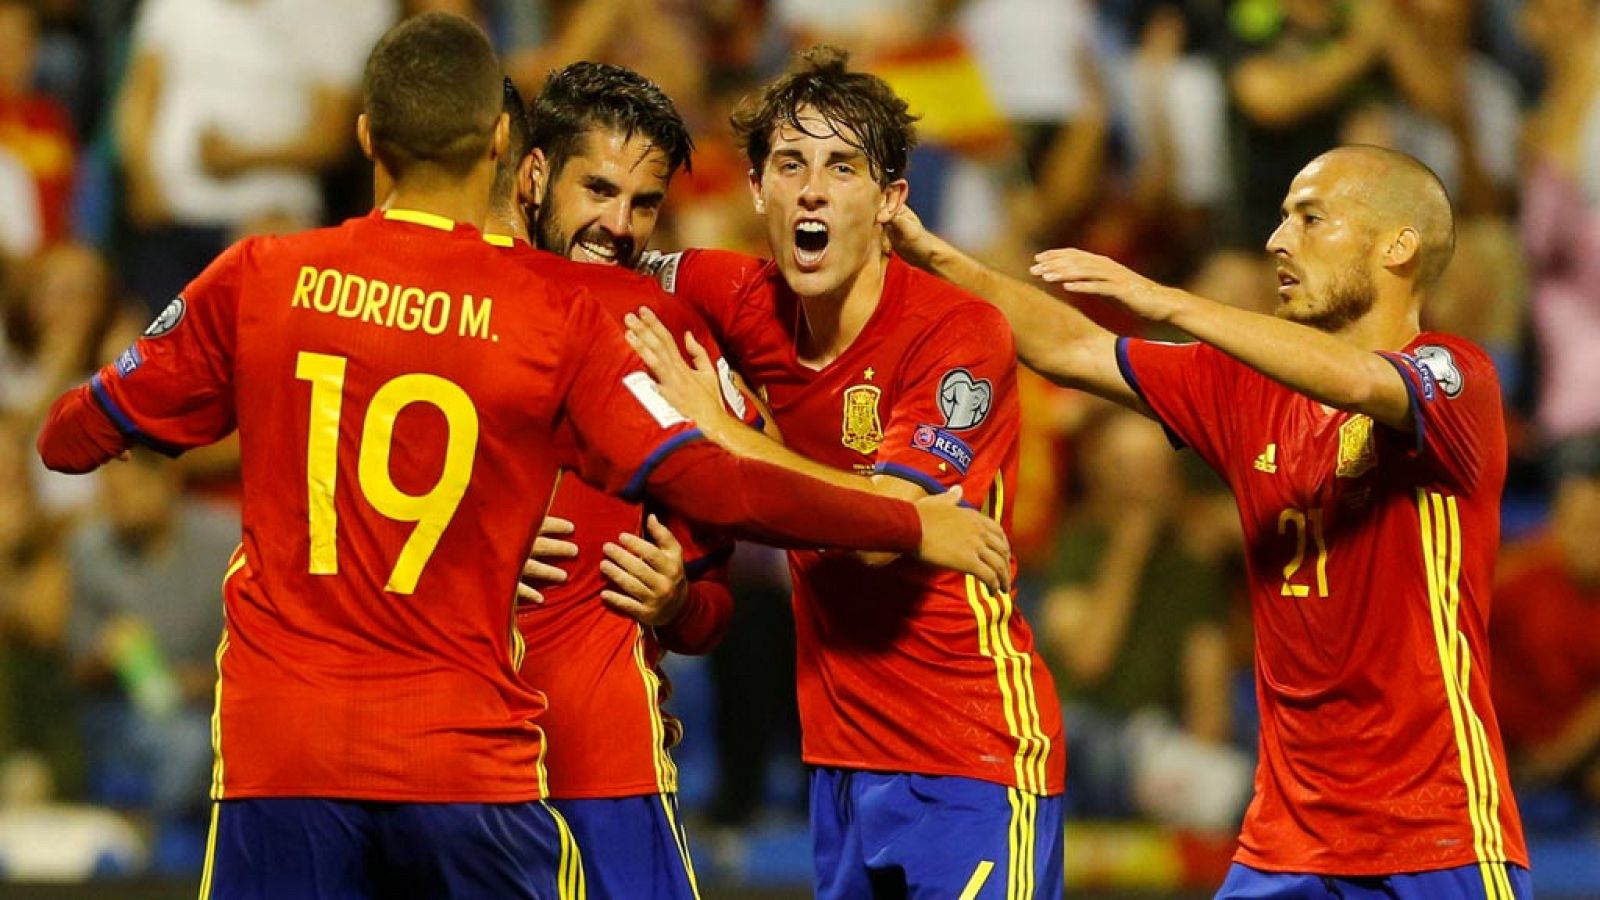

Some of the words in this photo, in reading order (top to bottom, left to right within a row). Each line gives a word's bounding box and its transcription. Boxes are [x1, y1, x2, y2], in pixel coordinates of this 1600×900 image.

[291, 265, 451, 335] RODRIGO
[458, 294, 499, 343] M.
[295, 351, 479, 595] 19
[1278, 507, 1329, 598] 21
